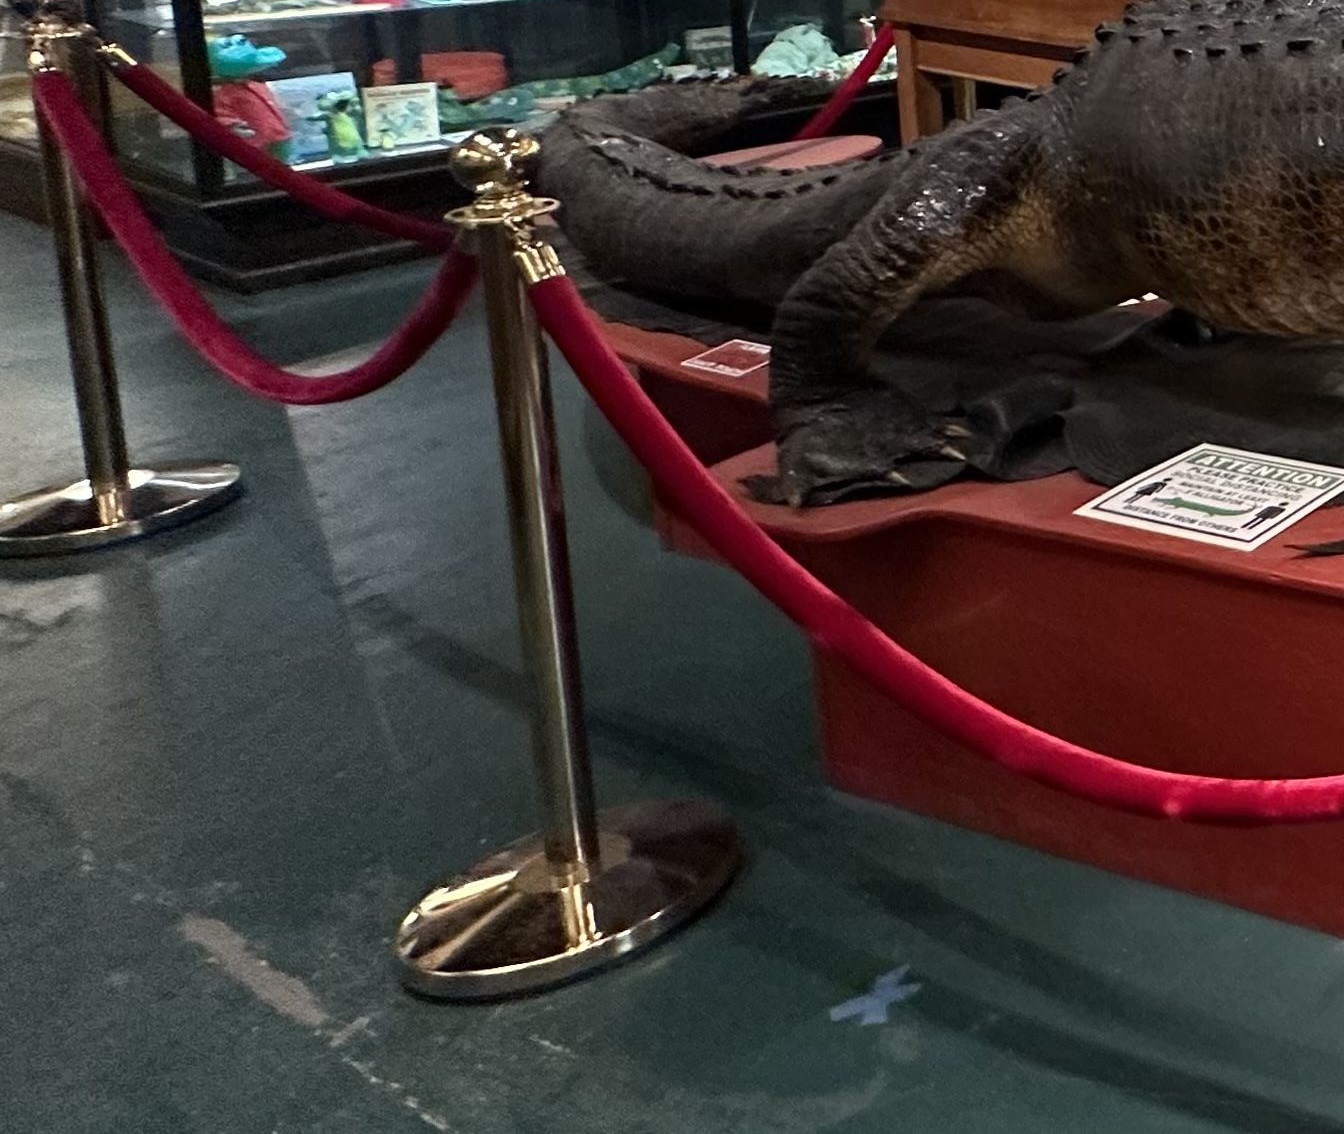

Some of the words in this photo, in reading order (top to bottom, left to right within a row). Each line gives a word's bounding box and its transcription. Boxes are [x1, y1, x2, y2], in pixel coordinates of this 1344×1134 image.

[1188, 467, 1239, 483] PLEASE
[1237, 477, 1306, 493] PRACTICE
[1196, 453, 1334, 489] ATTENTION
[1221, 481, 1302, 501] DISTANCING
